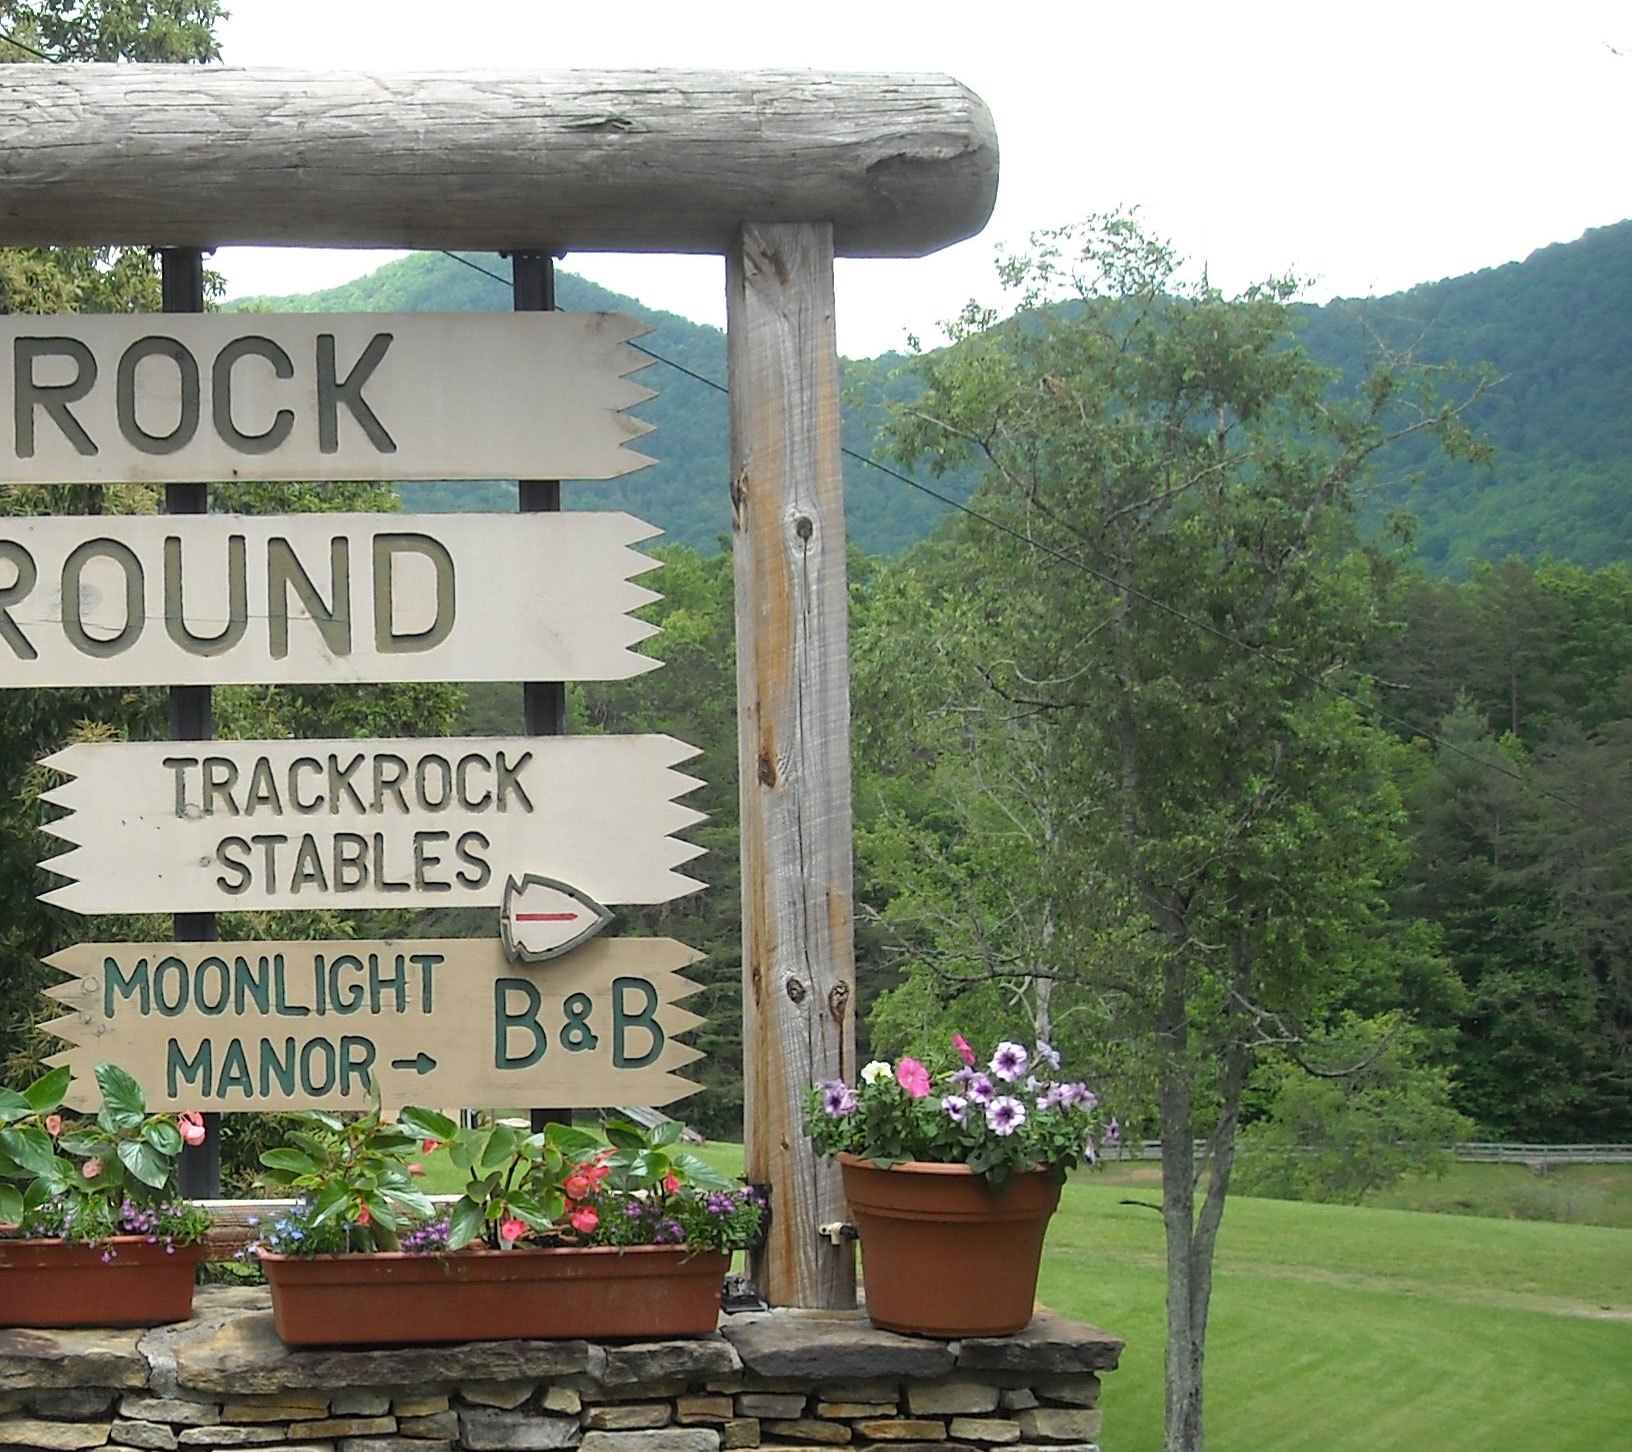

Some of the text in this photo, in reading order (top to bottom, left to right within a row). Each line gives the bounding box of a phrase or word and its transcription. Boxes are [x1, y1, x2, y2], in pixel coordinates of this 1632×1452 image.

[162, 750, 535, 818] TRACKROCK
[215, 831, 493, 894] STABLES
[103, 954, 445, 1018] MOONLIGHT
[494, 976, 666, 1070] B&B
[167, 1036, 377, 1099] MANOR
